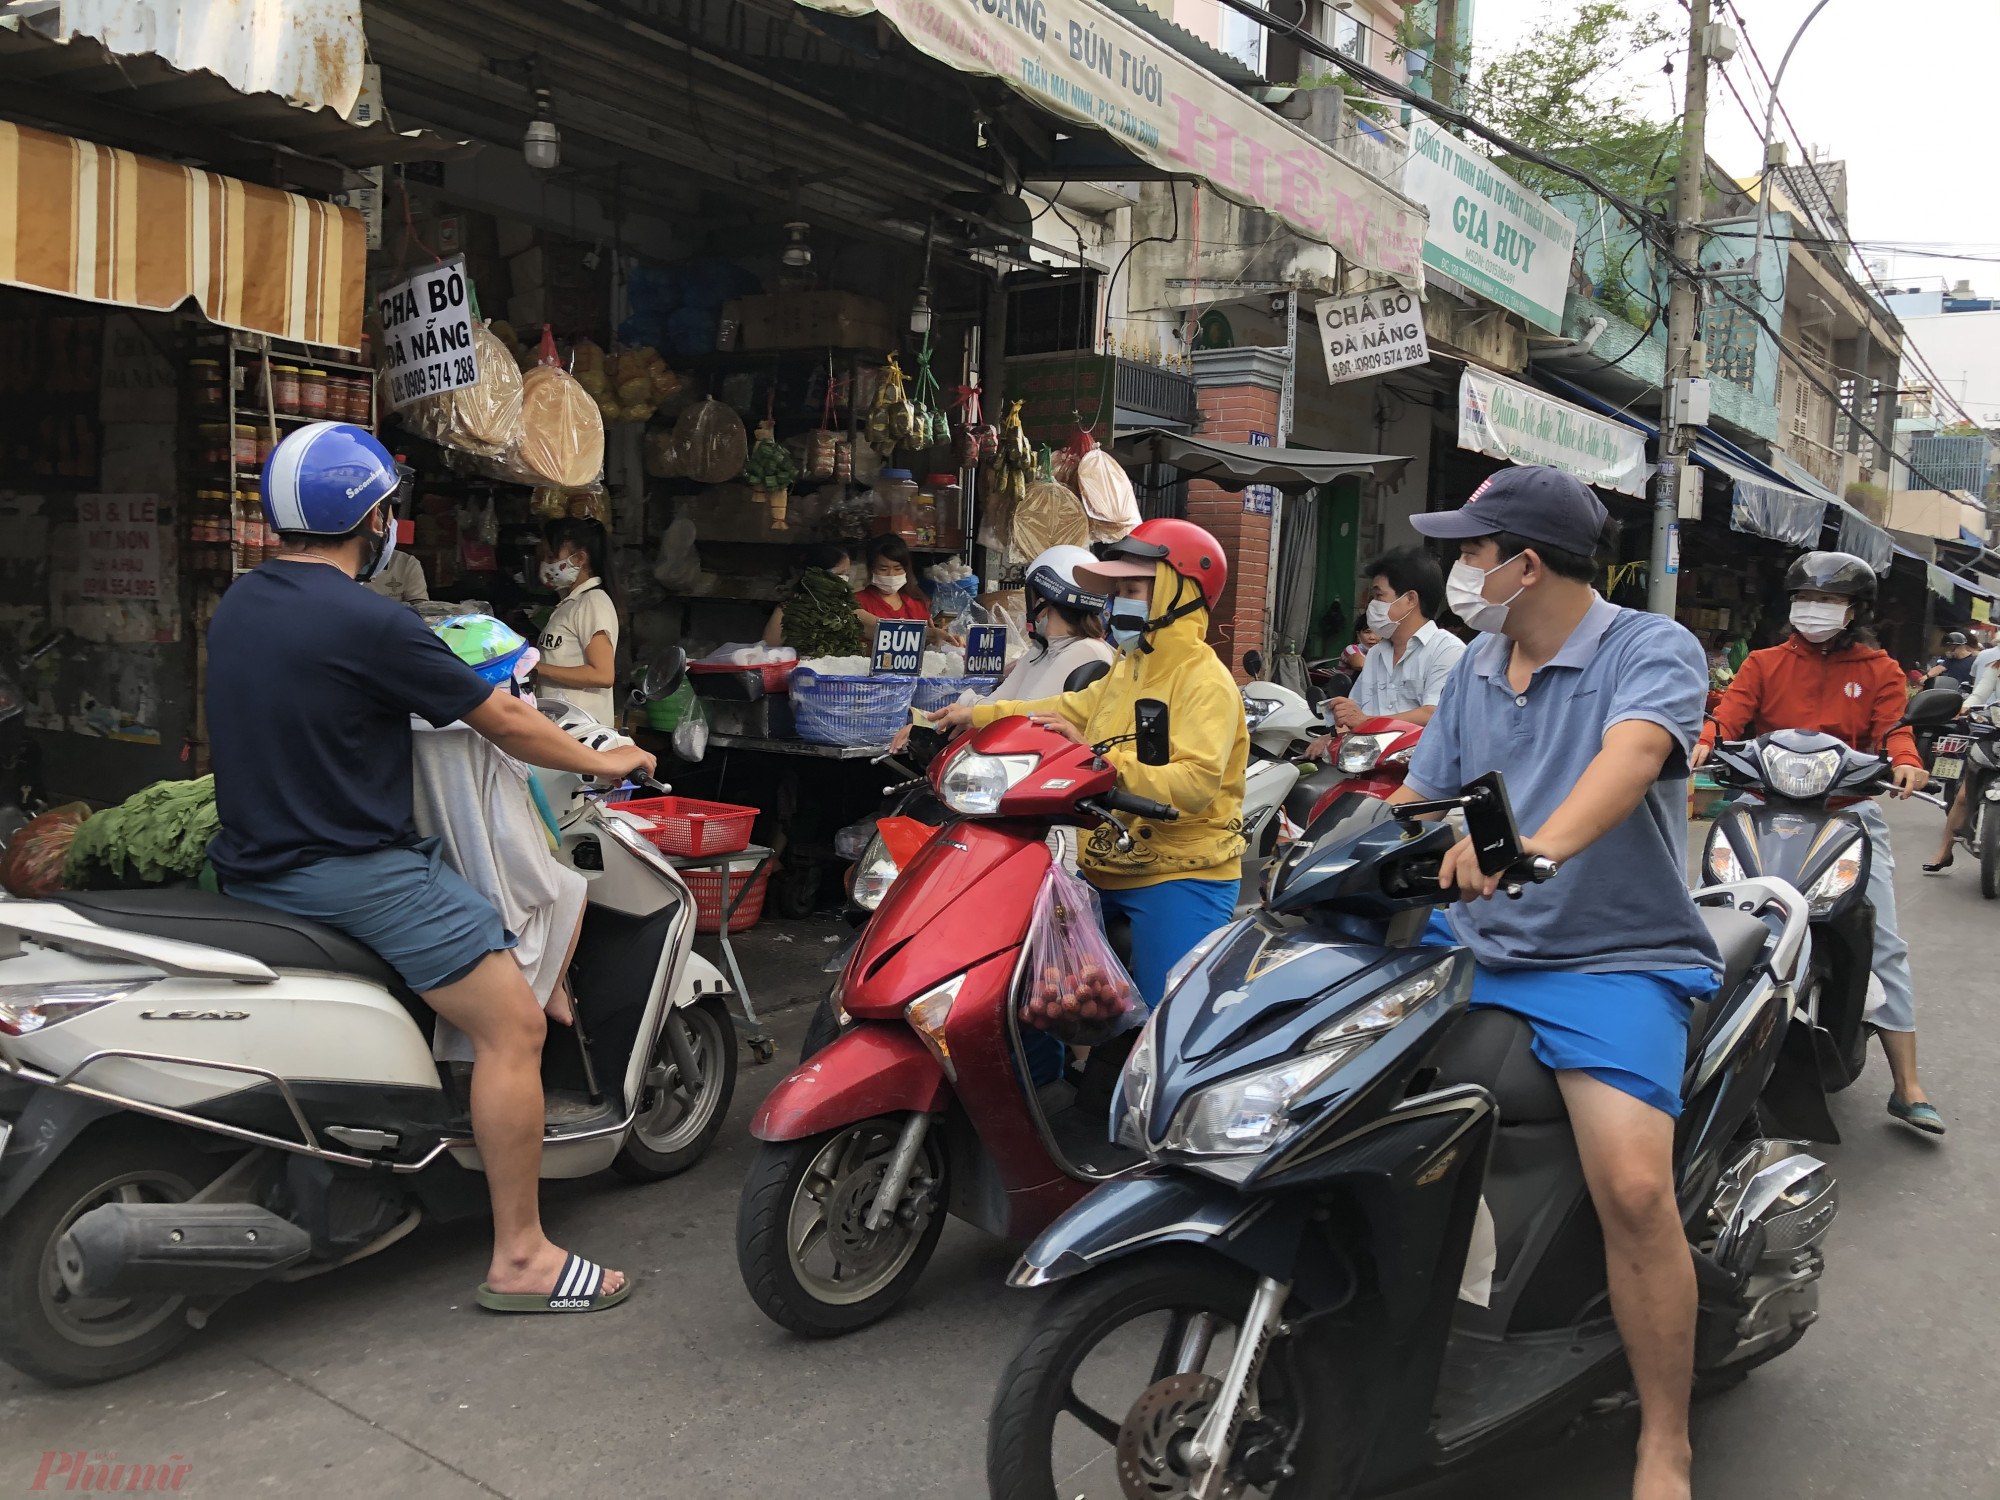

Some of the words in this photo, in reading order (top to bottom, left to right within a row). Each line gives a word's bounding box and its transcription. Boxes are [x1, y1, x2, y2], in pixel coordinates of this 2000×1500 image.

[1069, 19, 1113, 80] BÚN
[1119, 48, 1163, 108] TƯƠI
[1021, 55, 1048, 92] TRẦN
[1050, 73, 1069, 103] MAI
[1119, 107, 1138, 139] TÂN
[1414, 126, 1441, 164] CÔNG
[1442, 144, 1454, 172] TY
[1453, 153, 1477, 188] TNHH
[1453, 195, 1489, 249] GIA
[1493, 220, 1537, 274] HUY
[427, 265, 464, 314] BÒ
[1326, 295, 1377, 330] CHẢ
[1382, 289, 1412, 318] BÒ
[410, 317, 471, 361] NẴNG
[1330, 333, 1359, 357] ĐÀ
[1355, 353, 1381, 373] 0909
[1383, 349, 1403, 366] 574
[1404, 343, 1424, 361] 288
[404, 368, 427, 398] 0909
[428, 361, 452, 391] 574
[453, 355, 476, 386] 288
[1252, 433, 1270, 448] 130
[1506, 443, 1521, 458] 128
[106, 502, 121, 522] &
[877, 625, 921, 652] BÚN
[875, 652, 917, 670] 1.000
[139, 1008, 251, 1021] LEAD
[549, 1298, 590, 1308] adidas
